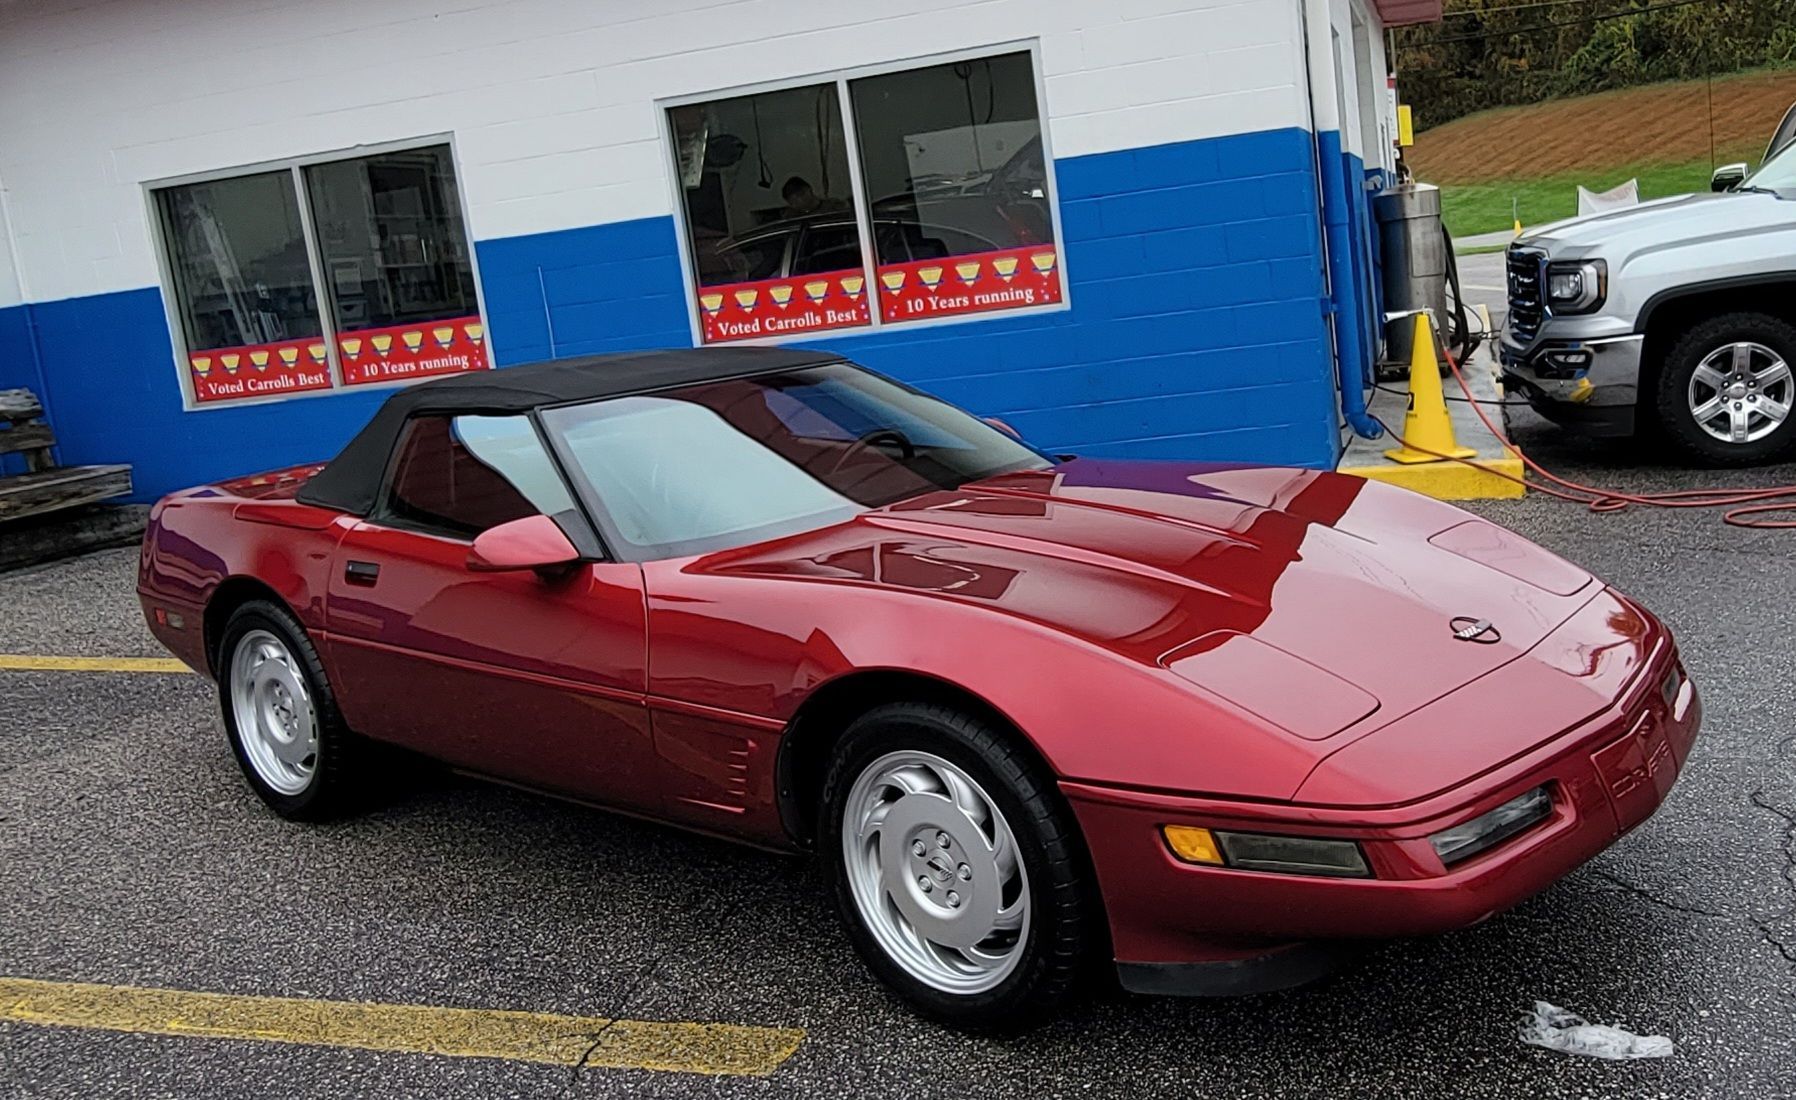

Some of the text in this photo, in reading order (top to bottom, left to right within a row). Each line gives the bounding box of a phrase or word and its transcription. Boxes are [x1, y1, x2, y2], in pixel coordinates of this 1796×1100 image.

[906, 287, 1035, 313] 10 Years running
[717, 309, 858, 336] Voted Carrolls Best
[363, 354, 470, 377] 10 Years running
[208, 372, 325, 395] Voted Carrolls Best
